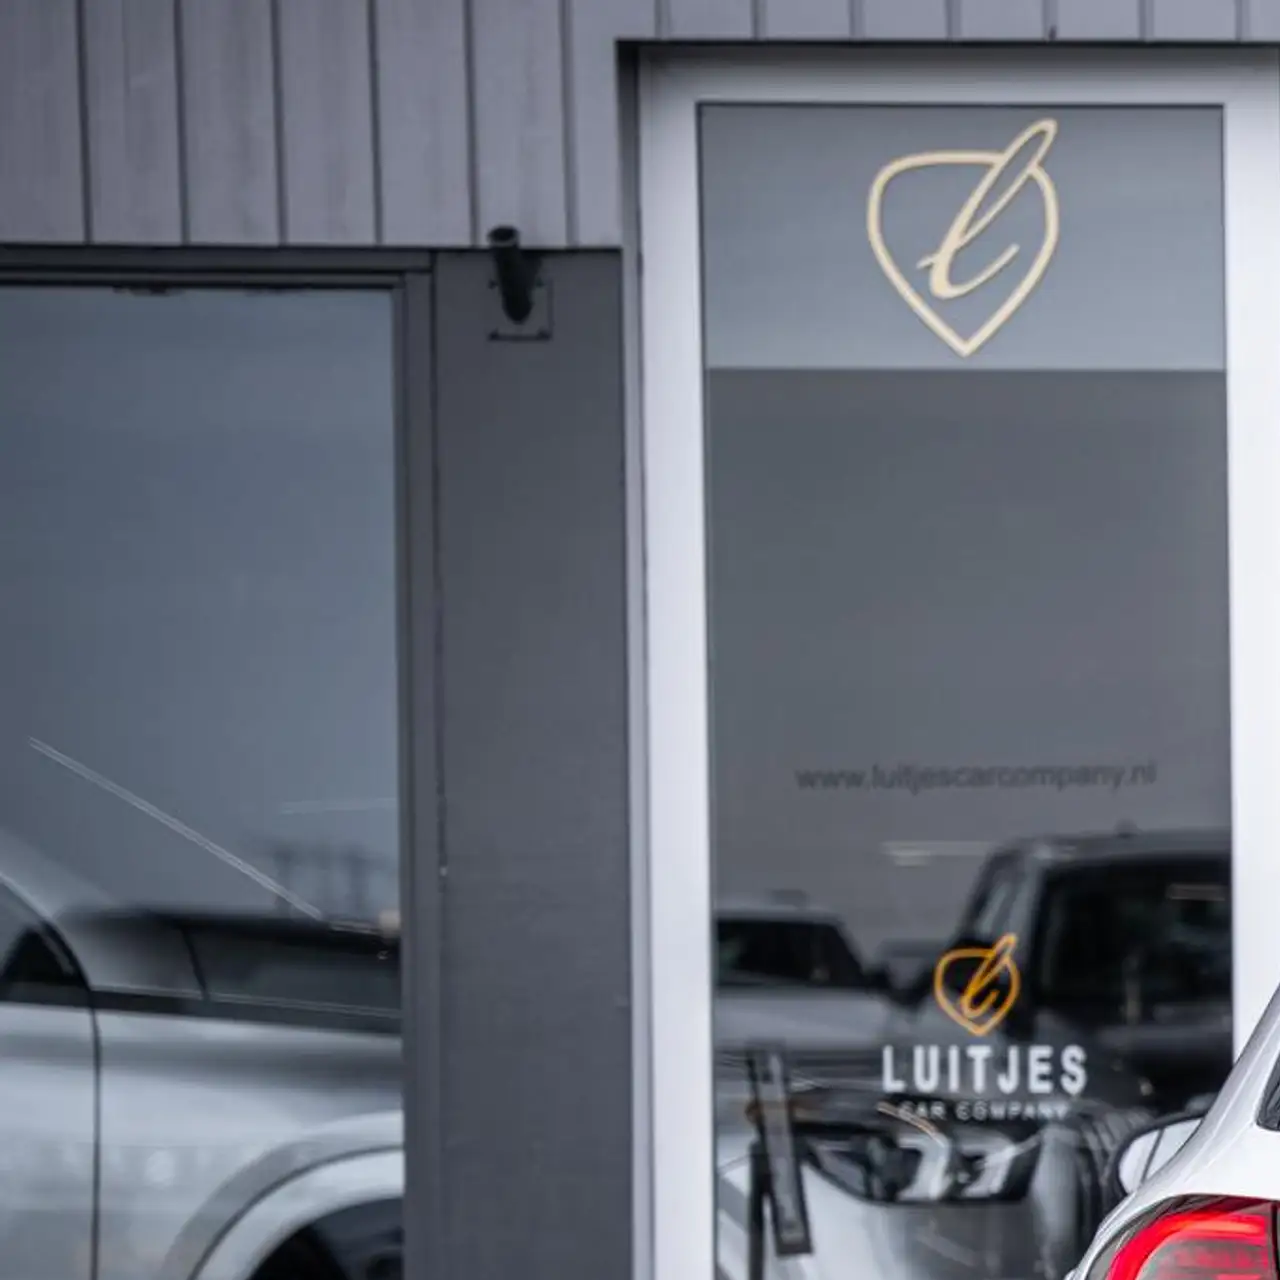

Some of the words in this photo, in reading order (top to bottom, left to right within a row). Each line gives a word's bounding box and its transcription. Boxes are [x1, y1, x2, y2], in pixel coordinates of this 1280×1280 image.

[794, 759, 1157, 796] www.luitjescarcompany.nl
[881, 1044, 1088, 1095] LUITJES
[899, 1100, 946, 1121] CAR
[955, 1100, 1070, 1121] COMPANY
